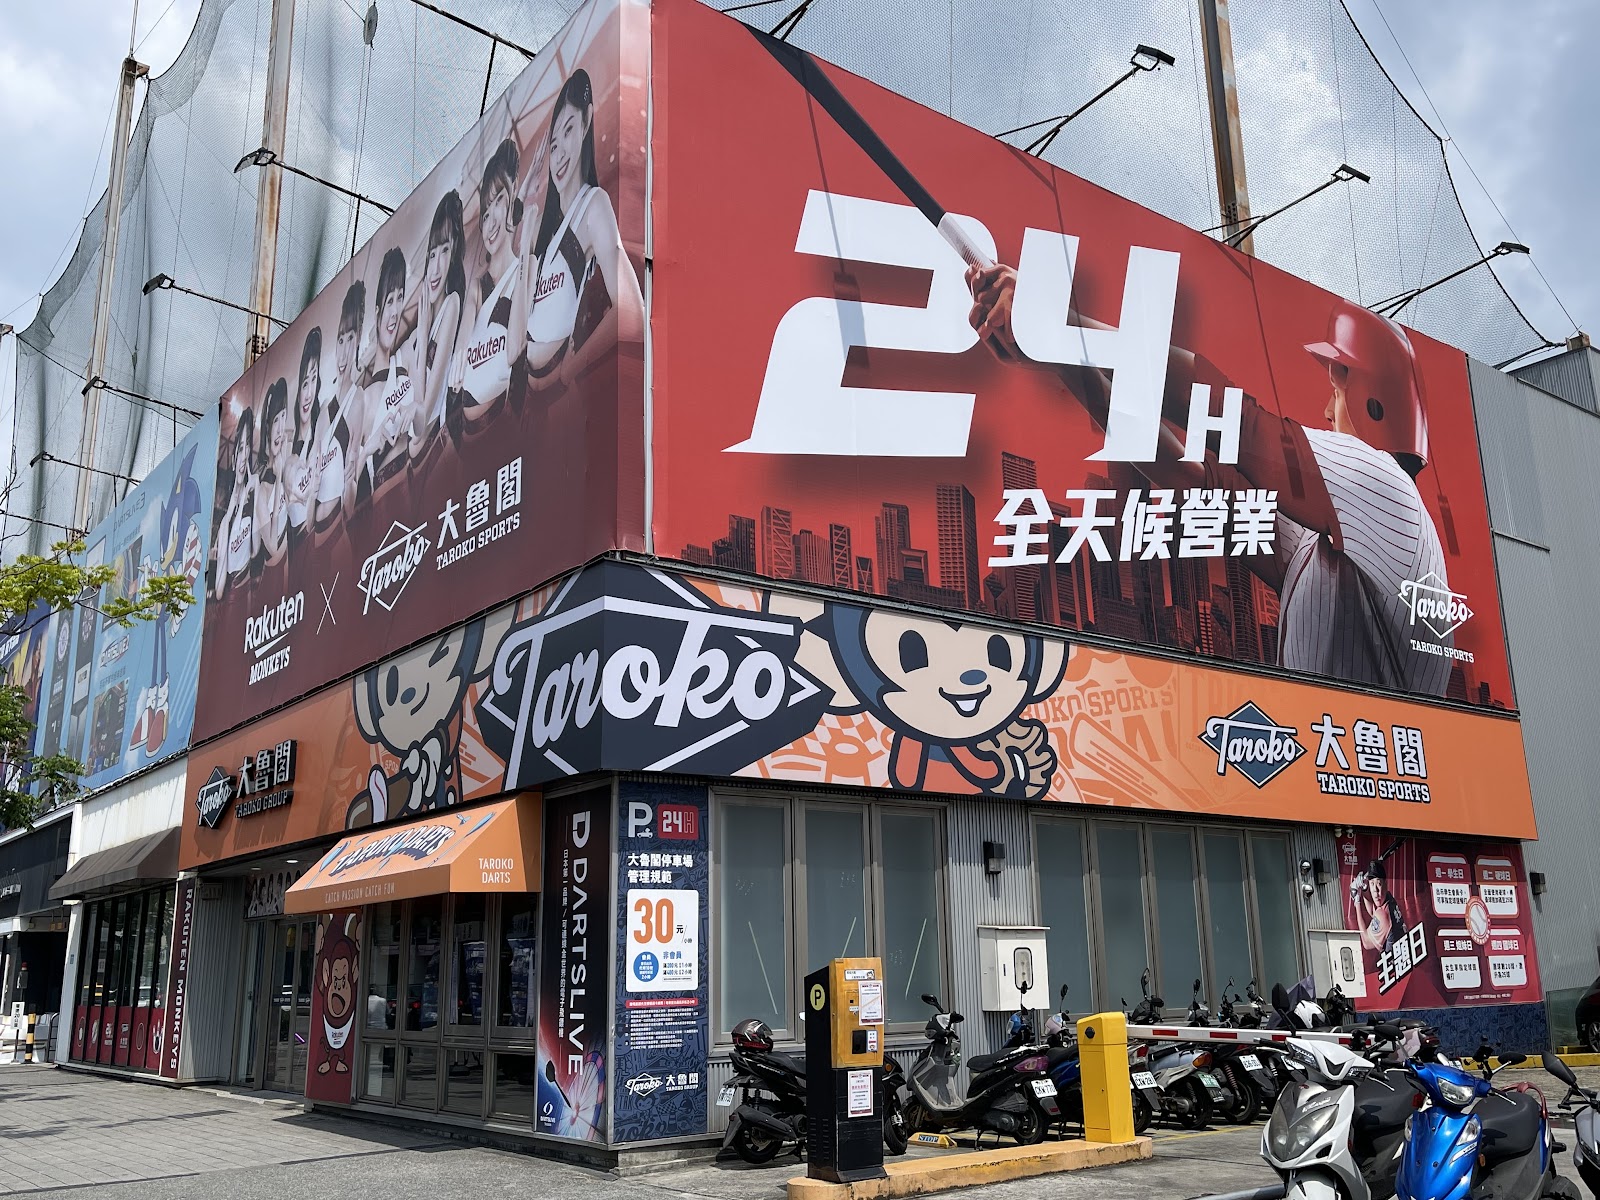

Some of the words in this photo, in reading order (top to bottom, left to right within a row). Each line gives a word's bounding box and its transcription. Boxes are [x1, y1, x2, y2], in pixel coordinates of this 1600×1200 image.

[436, 456, 523, 549] 大魯閣
[436, 538, 476, 571] TAROKO
[477, 512, 521, 549] SPORTS
[987, 487, 1279, 567] 全天候營業
[360, 521, 428, 616] Taroko
[243, 590, 305, 655] Rakuten
[1400, 579, 1468, 626] Taroko
[248, 646, 291, 686] MONKEYS
[1410, 639, 1443, 656] TAROKO
[1444, 646, 1475, 663] SPORTS
[493, 595, 794, 790] Taroko
[1206, 716, 1298, 774] Taroko
[1311, 713, 1428, 778] 大魯閣
[236, 740, 294, 799] 大魯閣
[1317, 772, 1376, 797] TAROKO
[1378, 779, 1431, 803] SPORTS
[198, 775, 231, 826] Taroko
[235, 796, 262, 818] TAROKO
[262, 789, 289, 811] GROUP
[627, 801, 653, 838] P
[662, 810, 695, 834] 24H
[479, 857, 514, 870] TAROKO
[481, 871, 511, 884] DARTS
[627, 853, 694, 867] 大魯閣停車場
[627, 869, 673, 883] 管理規範
[325, 892, 340, 904] CATCH
[341, 887, 363, 901] PASSION
[364, 884, 383, 898] CATCH
[179, 887, 194, 971] RAKUTEN
[633, 897, 674, 945] 30
[567, 857, 588, 1076] DARTSLIVE
[1376, 921, 1428, 994] 主題日
[814, 989, 822, 1006] P
[170, 979, 184, 1069] MONKEYS
[665, 1072, 699, 1087] 大魯閣
[918, 1134, 940, 1143] STOP
